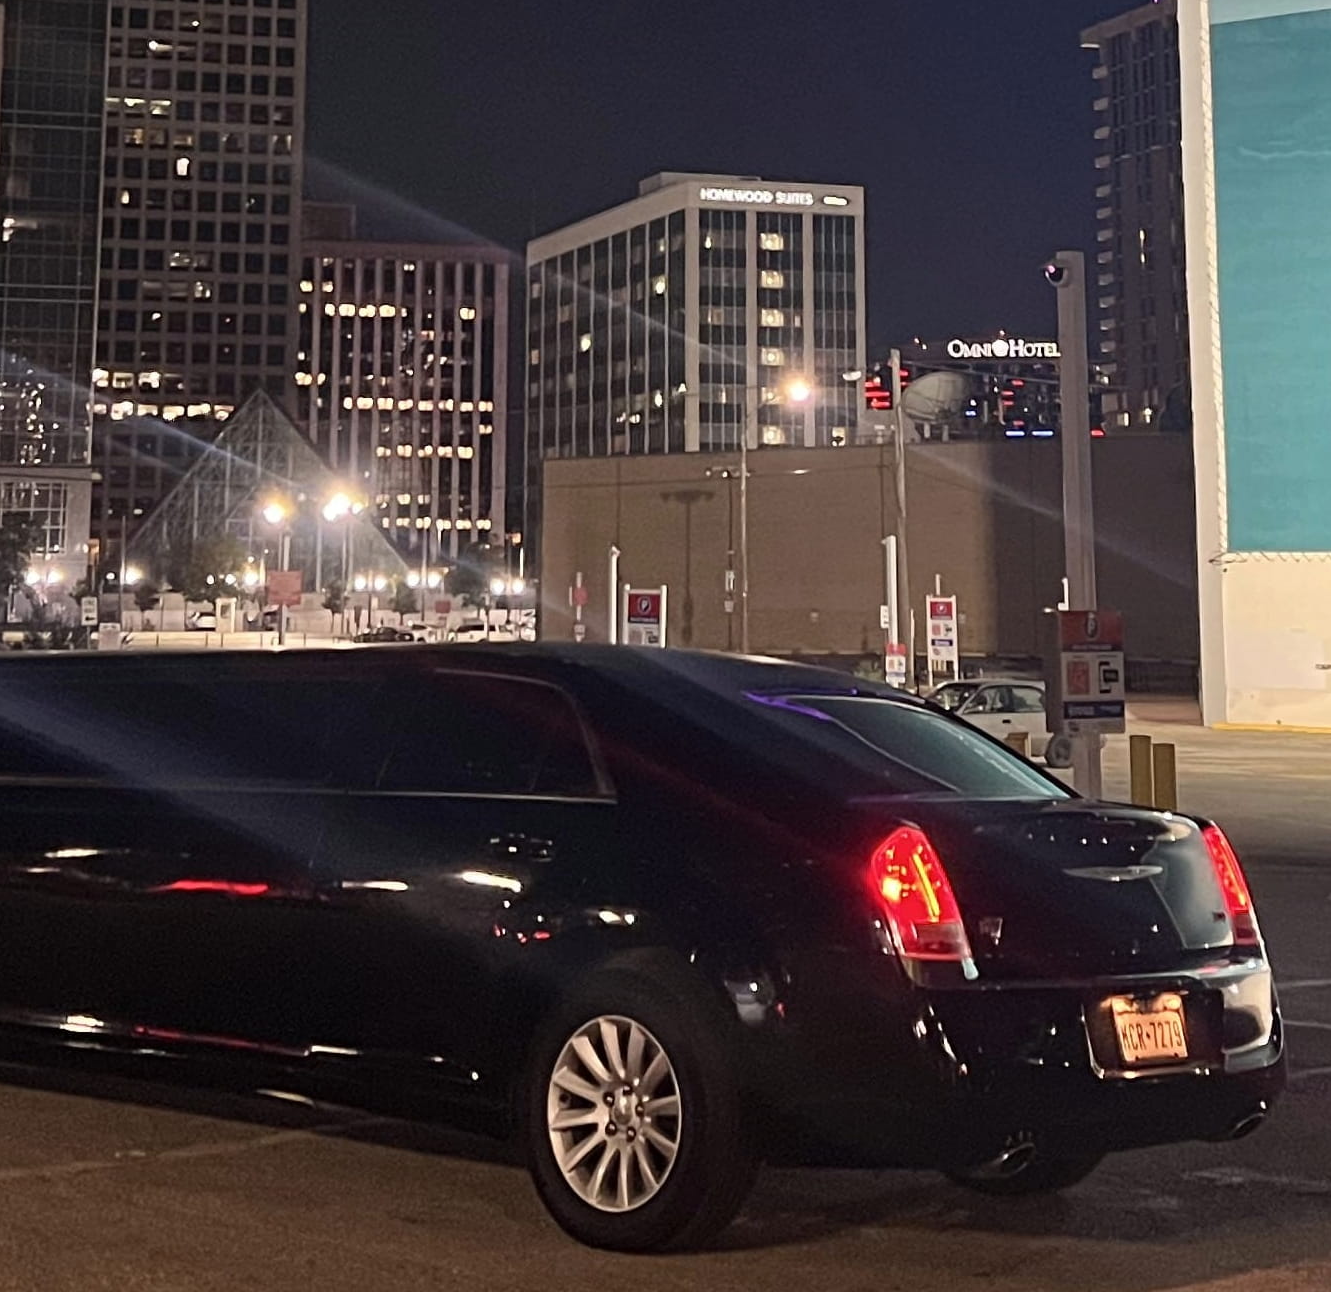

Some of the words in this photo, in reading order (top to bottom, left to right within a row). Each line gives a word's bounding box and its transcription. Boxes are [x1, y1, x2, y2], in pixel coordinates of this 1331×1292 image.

[700, 187, 774, 203] HOMEWOOD
[775, 191, 814, 206] SUITES
[947, 339, 993, 358] OMNI
